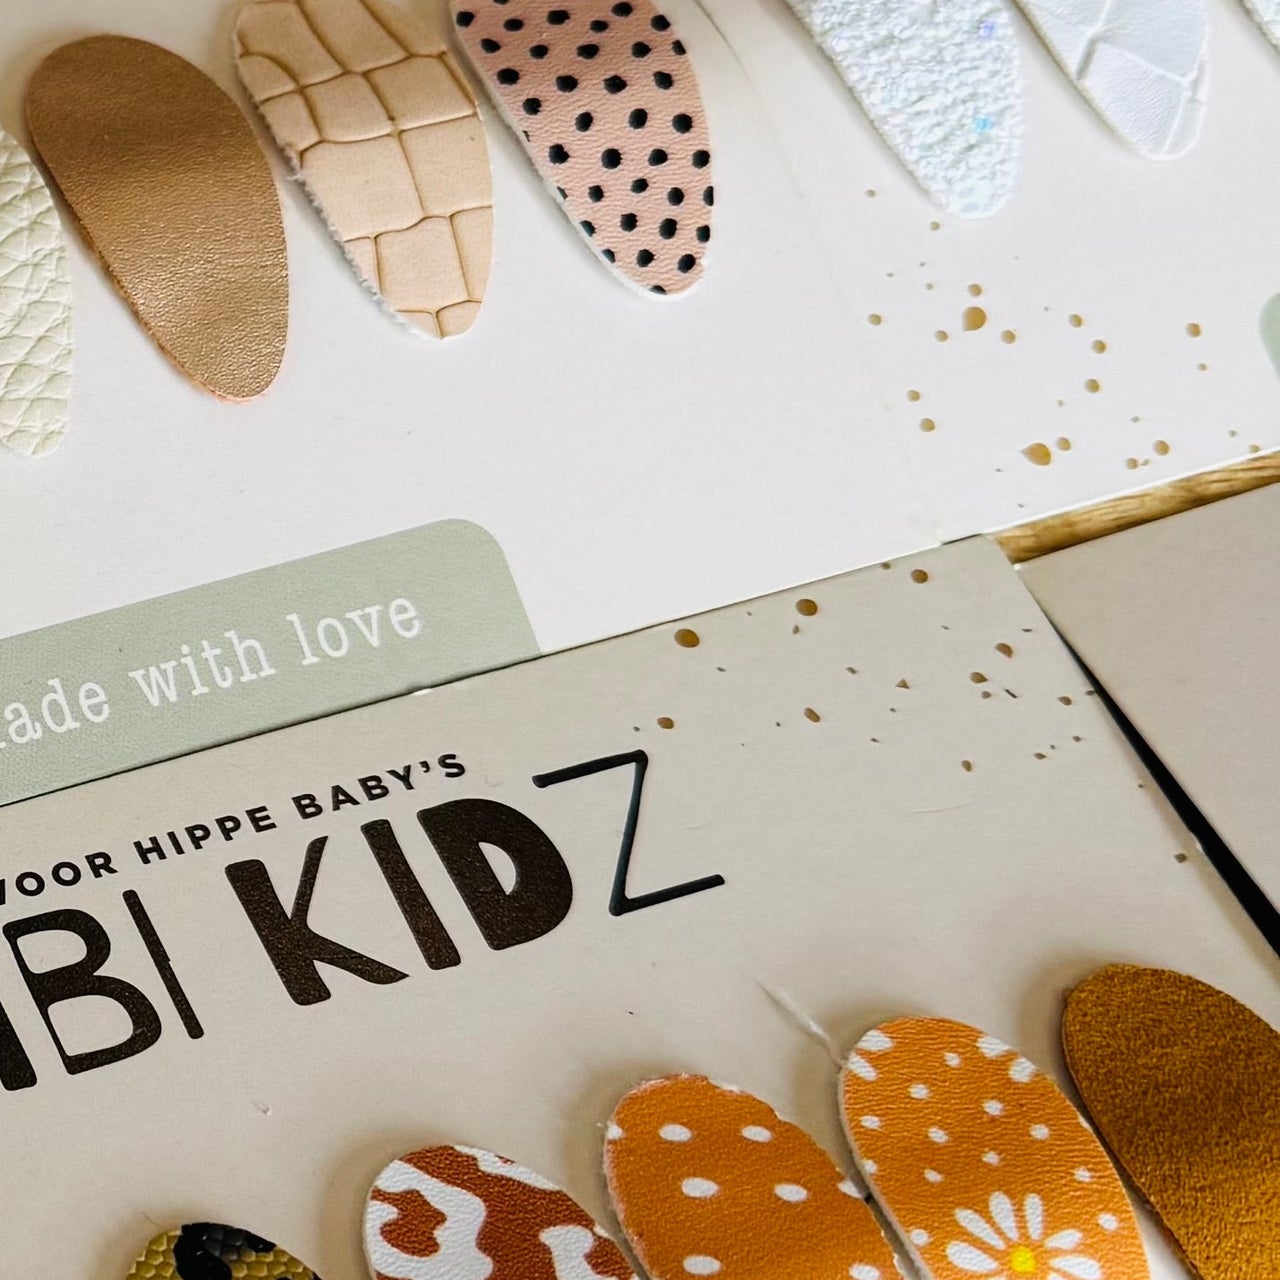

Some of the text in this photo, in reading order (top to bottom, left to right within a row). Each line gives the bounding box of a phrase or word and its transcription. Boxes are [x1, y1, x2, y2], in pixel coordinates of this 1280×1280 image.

[130, 628, 278, 708] with
[286, 596, 422, 666] love
[135, 804, 278, 866] HIPPE
[294, 751, 468, 821] BABY'S
[225, 748, 725, 1007] KIDZ
